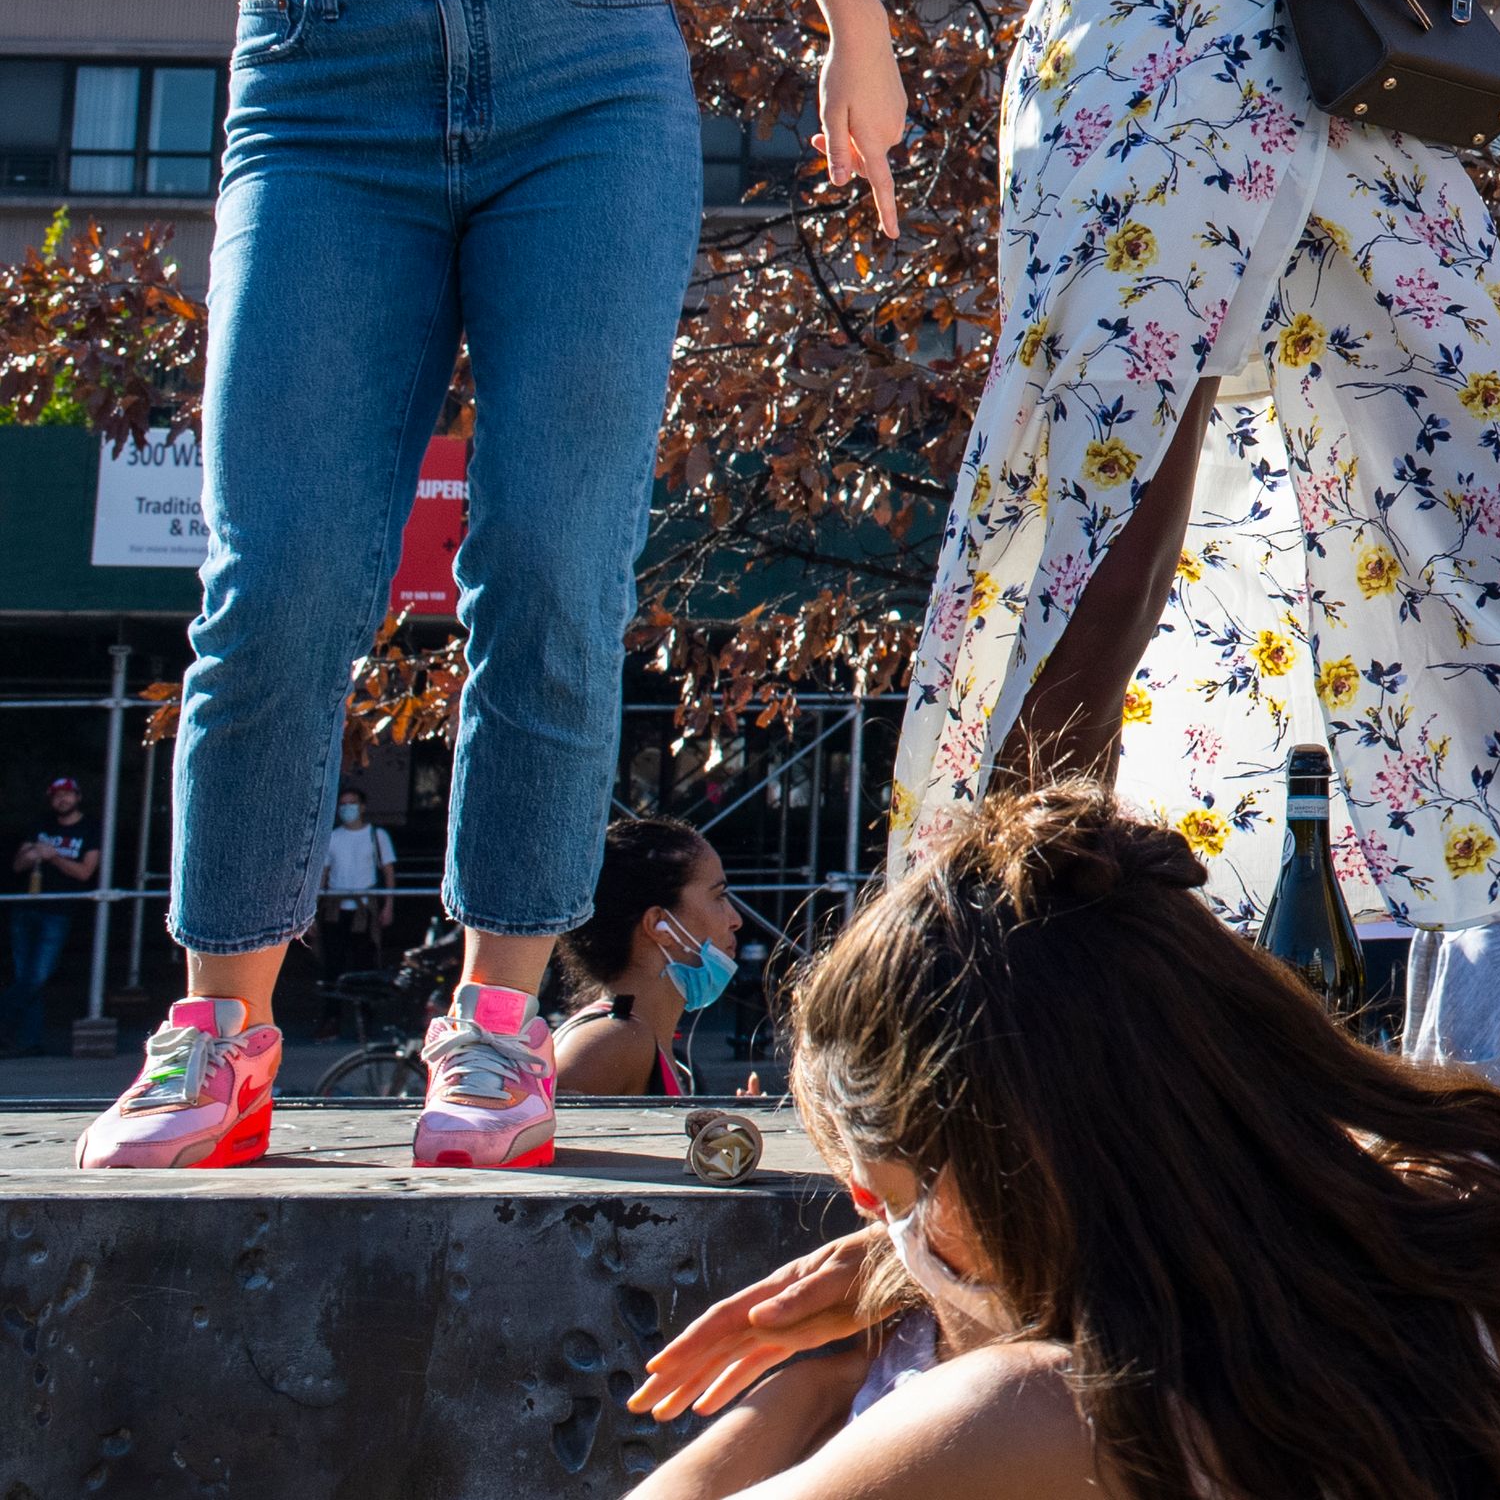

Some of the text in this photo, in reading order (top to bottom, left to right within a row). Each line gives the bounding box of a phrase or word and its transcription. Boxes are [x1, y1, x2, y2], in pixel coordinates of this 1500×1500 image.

[127, 442, 165, 466] 300
[136, 496, 202, 515] Traditio
[169, 518, 182, 536] &
